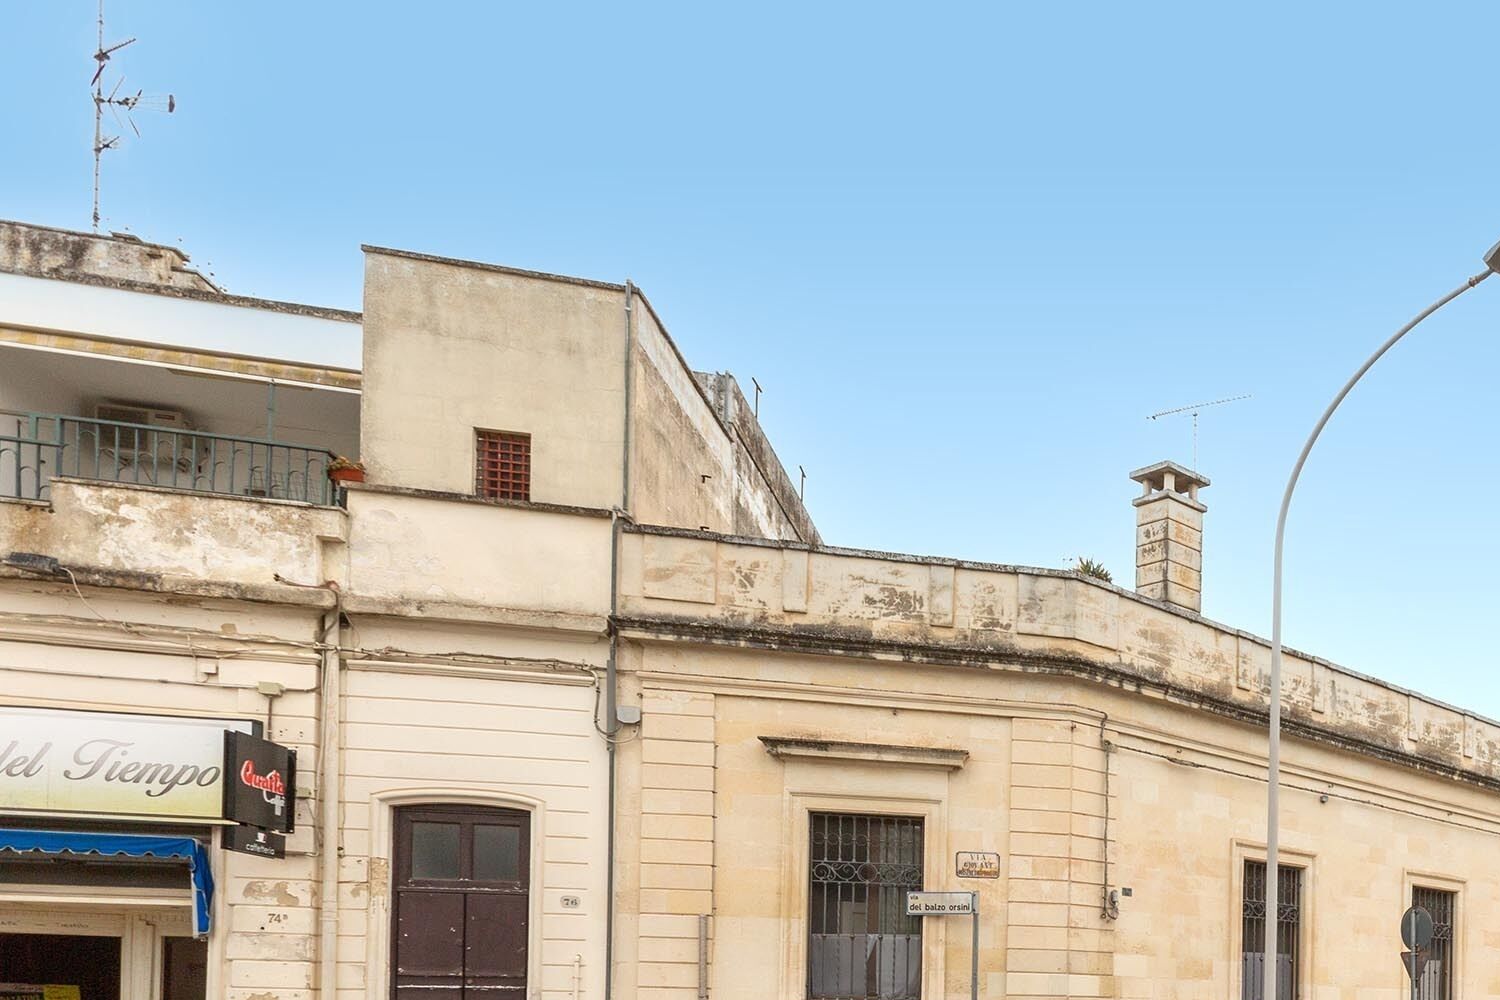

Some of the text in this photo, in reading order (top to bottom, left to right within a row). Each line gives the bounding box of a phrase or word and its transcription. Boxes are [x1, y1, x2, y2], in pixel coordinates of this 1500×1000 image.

[63, 738, 221, 797] Tiempo
[909, 903, 970, 911] del balzo orsini
